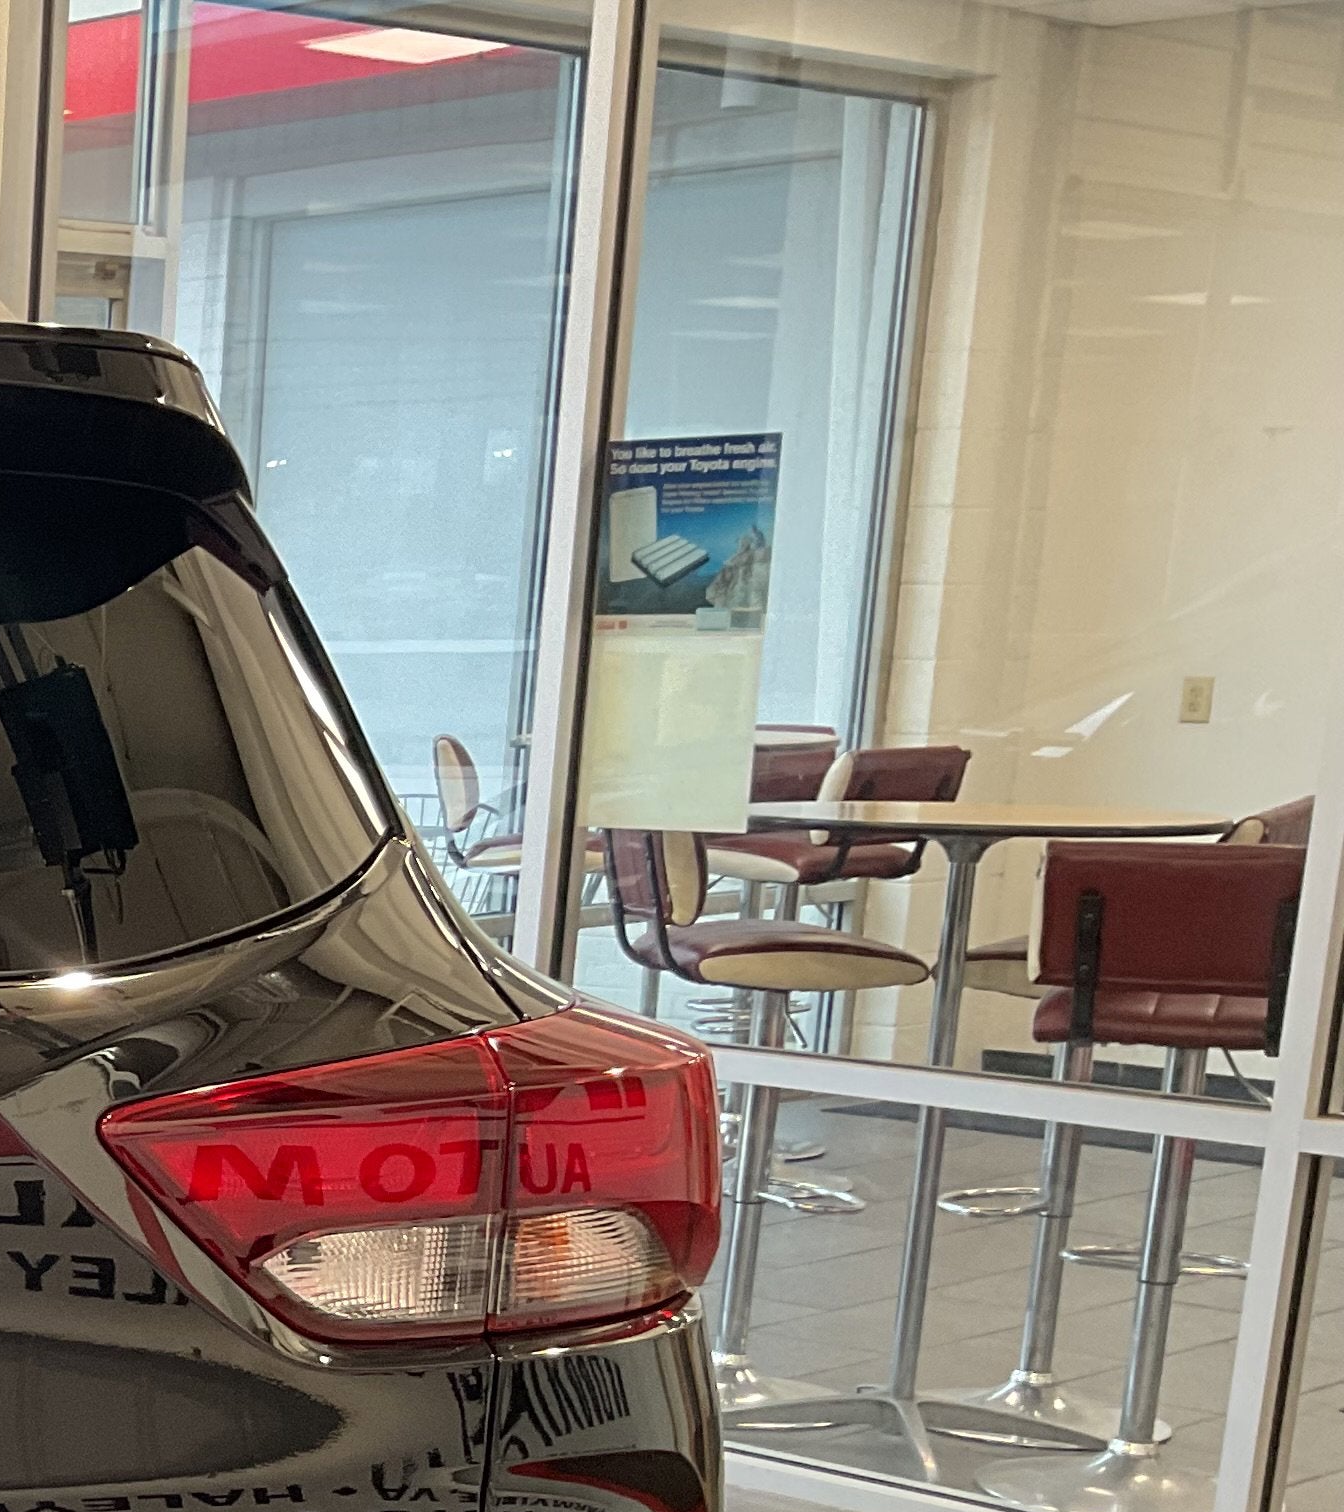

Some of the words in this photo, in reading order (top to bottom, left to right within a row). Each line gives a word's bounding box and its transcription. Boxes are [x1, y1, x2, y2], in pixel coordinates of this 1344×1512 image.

[612, 447, 632, 460] You
[635, 446, 657, 459] like
[659, 447, 672, 458] to
[674, 444, 721, 457] breathe
[724, 442, 755, 455] fresh
[610, 463, 627, 475] So
[629, 462, 658, 474] does
[659, 462, 687, 475] your
[689, 459, 730, 473] Toyota
